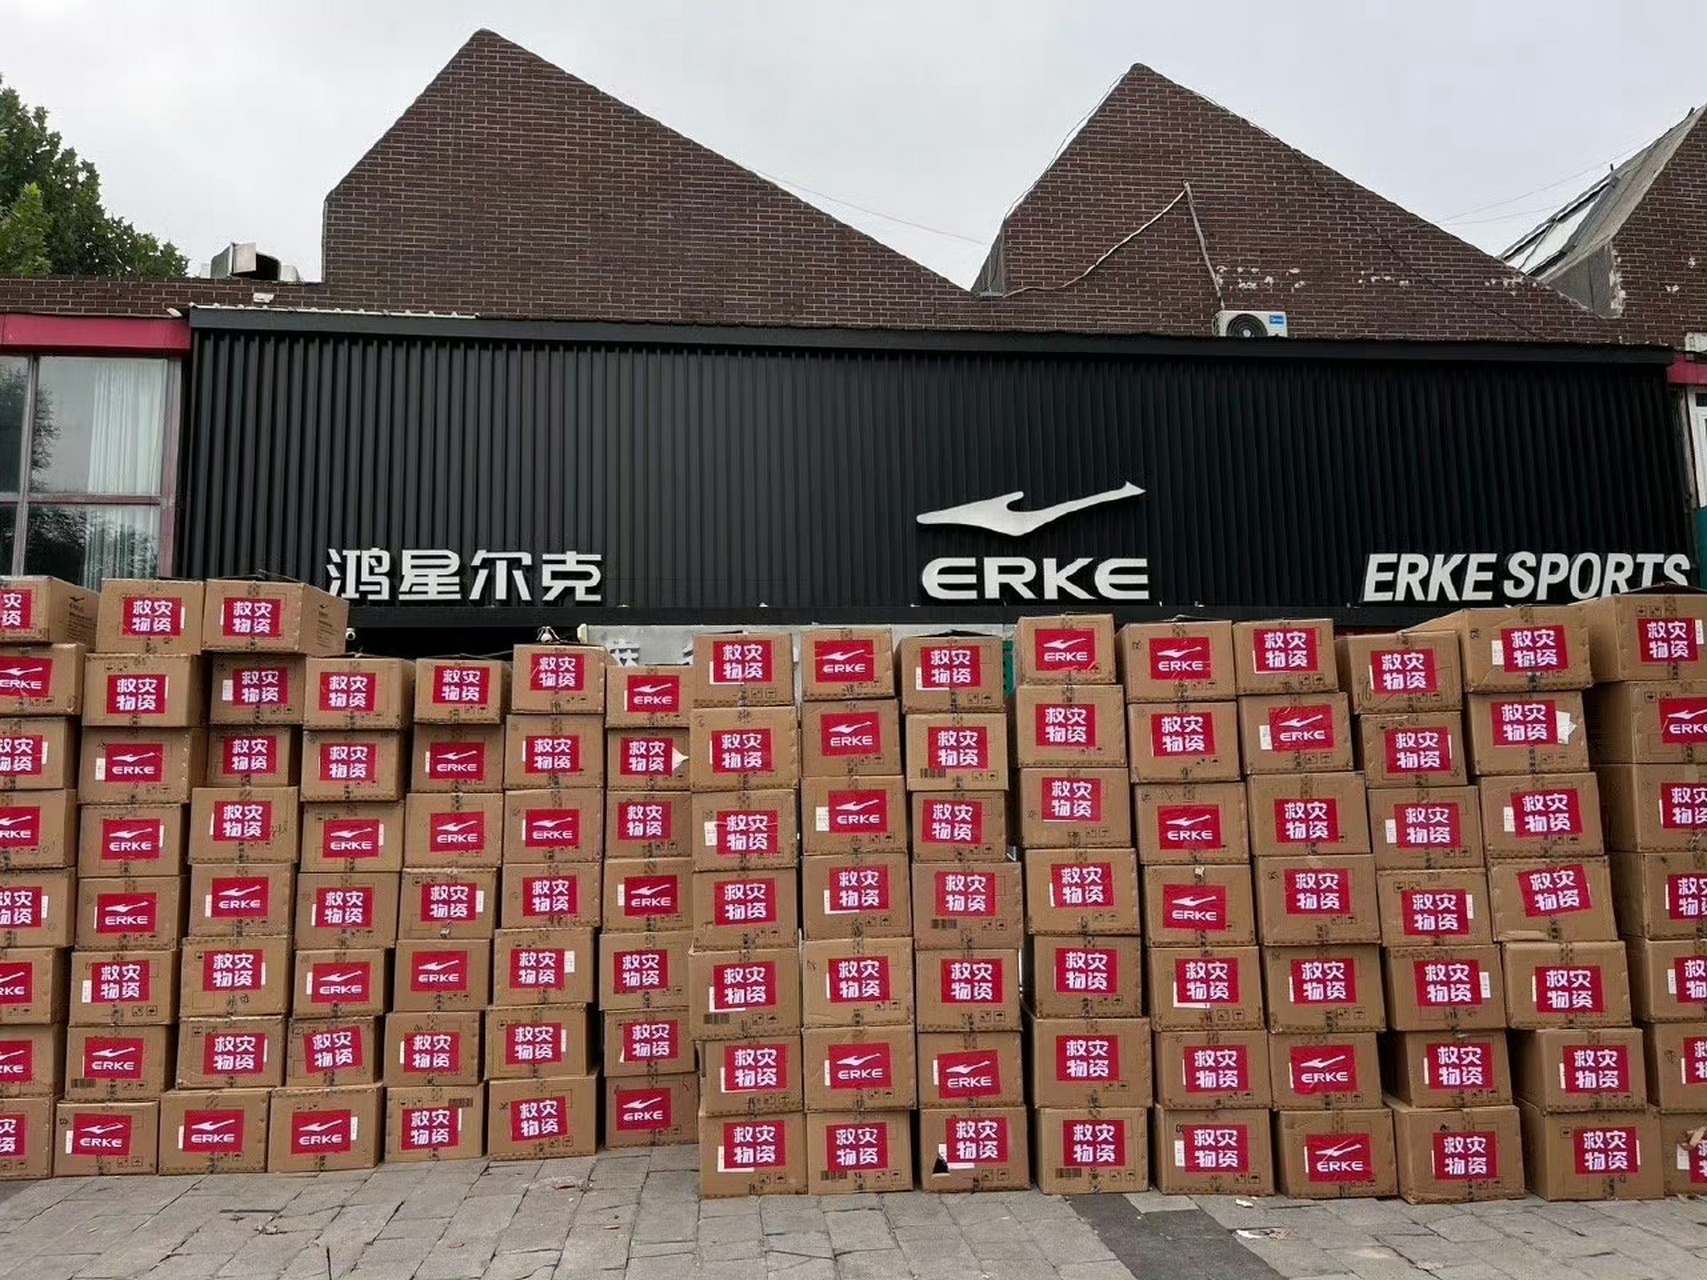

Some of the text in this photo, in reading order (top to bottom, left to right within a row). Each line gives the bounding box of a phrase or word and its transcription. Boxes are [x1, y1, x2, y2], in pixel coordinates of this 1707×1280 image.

[326, 547, 602, 601] 鸿星尔克
[921, 557, 1149, 600] ERKE
[1363, 551, 1690, 602] ERKE SPORTS
[132, 599, 173, 617] 救灾
[233, 600, 273, 618] 救灾
[131, 615, 172, 633] 物资
[232, 617, 272, 634] 物资
[1646, 620, 1687, 640] 救灾
[1263, 630, 1307, 650] 救灾
[1649, 639, 1689, 659] 物资
[538, 656, 576, 672] 救灾
[930, 649, 971, 666] 救灾
[1044, 651, 1088, 662] ERKE
[1158, 660, 1204, 672] ERKE
[1265, 649, 1308, 669] 物资
[1381, 651, 1425, 672] 救灾
[443, 669, 481, 685] 救灾
[822, 663, 866, 674] ERKE
[931, 667, 972, 686] 物资
[0, 678, 42, 690] ERKE
[116, 677, 158, 694] 救灾
[329, 674, 368, 692] 救灾
[538, 671, 576, 688] 物资
[1382, 671, 1427, 691] 物资
[116, 694, 157, 712] 物资
[328, 691, 367, 708] 物资
[441, 685, 480, 702] 物资
[633, 695, 672, 705] ERKE
[1501, 702, 1546, 723] 救灾
[1161, 715, 1204, 734] 救灾
[1503, 723, 1548, 742] 物资
[534, 737, 572, 754] 救灾
[721, 732, 763, 750] 救灾
[830, 735, 873, 747] ERKE
[937, 729, 979, 748] 救灾
[1162, 734, 1205, 753] 物资
[1279, 730, 1326, 742] ERKE
[1395, 731, 1440, 750] 救灾
[329, 745, 369, 761] 救灾
[533, 755, 571, 770] 物资
[722, 751, 763, 769] 物资
[937, 748, 979, 767] 物资
[1396, 750, 1441, 769] 物资
[112, 765, 155, 775] ERKE
[329, 762, 368, 779] 物资
[436, 763, 477, 772] ERKE
[1051, 780, 1093, 800] 救灾
[223, 803, 264, 821] 救灾
[932, 802, 974, 822] 救灾
[1051, 799, 1092, 818] 物资
[1284, 800, 1328, 820] 救灾
[1522, 792, 1569, 813] 救灾
[836, 814, 881, 825] ERKE
[1405, 806, 1450, 825] 救灾
[1524, 812, 1571, 833] 物资
[223, 820, 262, 838] 物资
[436, 833, 478, 844] ERKE
[532, 830, 573, 840] ERKE
[931, 821, 973, 841] 物资
[1167, 830, 1213, 841] ERKE
[1285, 820, 1329, 840] 物资
[1406, 826, 1451, 844] 物资
[109, 841, 152, 852] ERKE
[330, 840, 373, 851] ERKE
[838, 869, 880, 888] 救灾
[1060, 865, 1103, 885] 救灾
[1295, 872, 1340, 890] 救灾
[1529, 869, 1576, 892] 救灾
[532, 878, 570, 896] 救灾
[724, 882, 767, 902] 救灾
[1062, 884, 1104, 905] 物资
[218, 899, 261, 910] ERKE
[325, 890, 364, 907] 救灾
[532, 895, 569, 913] 物资
[630, 897, 671, 908] ERKE
[839, 888, 880, 908] 物资
[1296, 892, 1340, 910] 物资
[1411, 893, 1457, 911] 救灾
[1534, 888, 1580, 911] 物资
[105, 915, 148, 926] ERKE
[324, 907, 363, 924] 物资
[724, 902, 767, 921] 物资
[1172, 909, 1217, 921] ERKE
[1413, 913, 1459, 931] 物资
[212, 952, 255, 970] 救灾
[622, 953, 660, 971] 救灾
[838, 959, 880, 980] 救灾
[1065, 951, 1108, 971] 救灾
[1185, 961, 1228, 980] 救灾
[1301, 960, 1345, 981] 救灾
[101, 963, 141, 982] 救灾
[212, 969, 253, 988] 物资
[418, 973, 460, 983] ERKE
[622, 969, 660, 987] 物资
[723, 966, 766, 985] 救灾
[950, 961, 993, 981] 救灾
[1065, 970, 1108, 991] 物资
[1424, 963, 1470, 982] 救灾
[1546, 969, 1592, 989] 救灾
[100, 981, 140, 1000] 物资
[319, 984, 363, 995] ERKE
[724, 985, 767, 1005] 物资
[839, 979, 881, 999] 物资
[951, 981, 993, 1001] 物资
[1186, 981, 1230, 1001] 物资
[1302, 980, 1347, 1001] 物资
[1426, 983, 1472, 1003] 物资
[1546, 990, 1593, 1009] 物资
[214, 1035, 256, 1053] 救灾
[413, 1033, 452, 1052] 救灾
[514, 1025, 554, 1044] 救灾
[514, 1043, 553, 1060] 物资
[734, 1047, 778, 1068] 救灾
[1066, 1039, 1109, 1057] 救灾
[1437, 1045, 1482, 1065] 救灾
[91, 1061, 135, 1071] ERKE
[213, 1053, 255, 1071] 物资
[412, 1052, 450, 1069] 物资
[1194, 1048, 1238, 1068] 救灾
[1573, 1048, 1618, 1068] 救灾
[734, 1067, 778, 1088] 物资
[837, 1068, 884, 1080] ERKE
[1066, 1058, 1109, 1078] 物资
[1301, 1071, 1349, 1084] ERKE
[1438, 1066, 1484, 1086] 物资
[947, 1076, 992, 1089] ERKE
[1195, 1069, 1239, 1089] 物资
[1575, 1070, 1620, 1089] 物资
[410, 1108, 451, 1128] 救灾
[623, 1110, 663, 1122] ERKE
[191, 1133, 235, 1144] ERKE
[410, 1127, 450, 1146] 物资
[733, 1124, 776, 1144] 救灾
[835, 1127, 878, 1147] 救灾
[955, 1119, 998, 1140] 救灾
[1073, 1123, 1116, 1142] 救灾
[1193, 1128, 1238, 1148] 救灾
[79, 1137, 123, 1148] ERKE
[298, 1133, 343, 1146] ERKE
[1443, 1135, 1487, 1155] 救灾
[733, 1144, 776, 1164] 物资
[836, 1147, 879, 1167] 物资
[956, 1140, 999, 1160] 物资
[1073, 1143, 1116, 1163] 物资
[1194, 1149, 1239, 1168] 物资
[1316, 1160, 1364, 1173] ERKE
[1444, 1156, 1488, 1176] 物资
